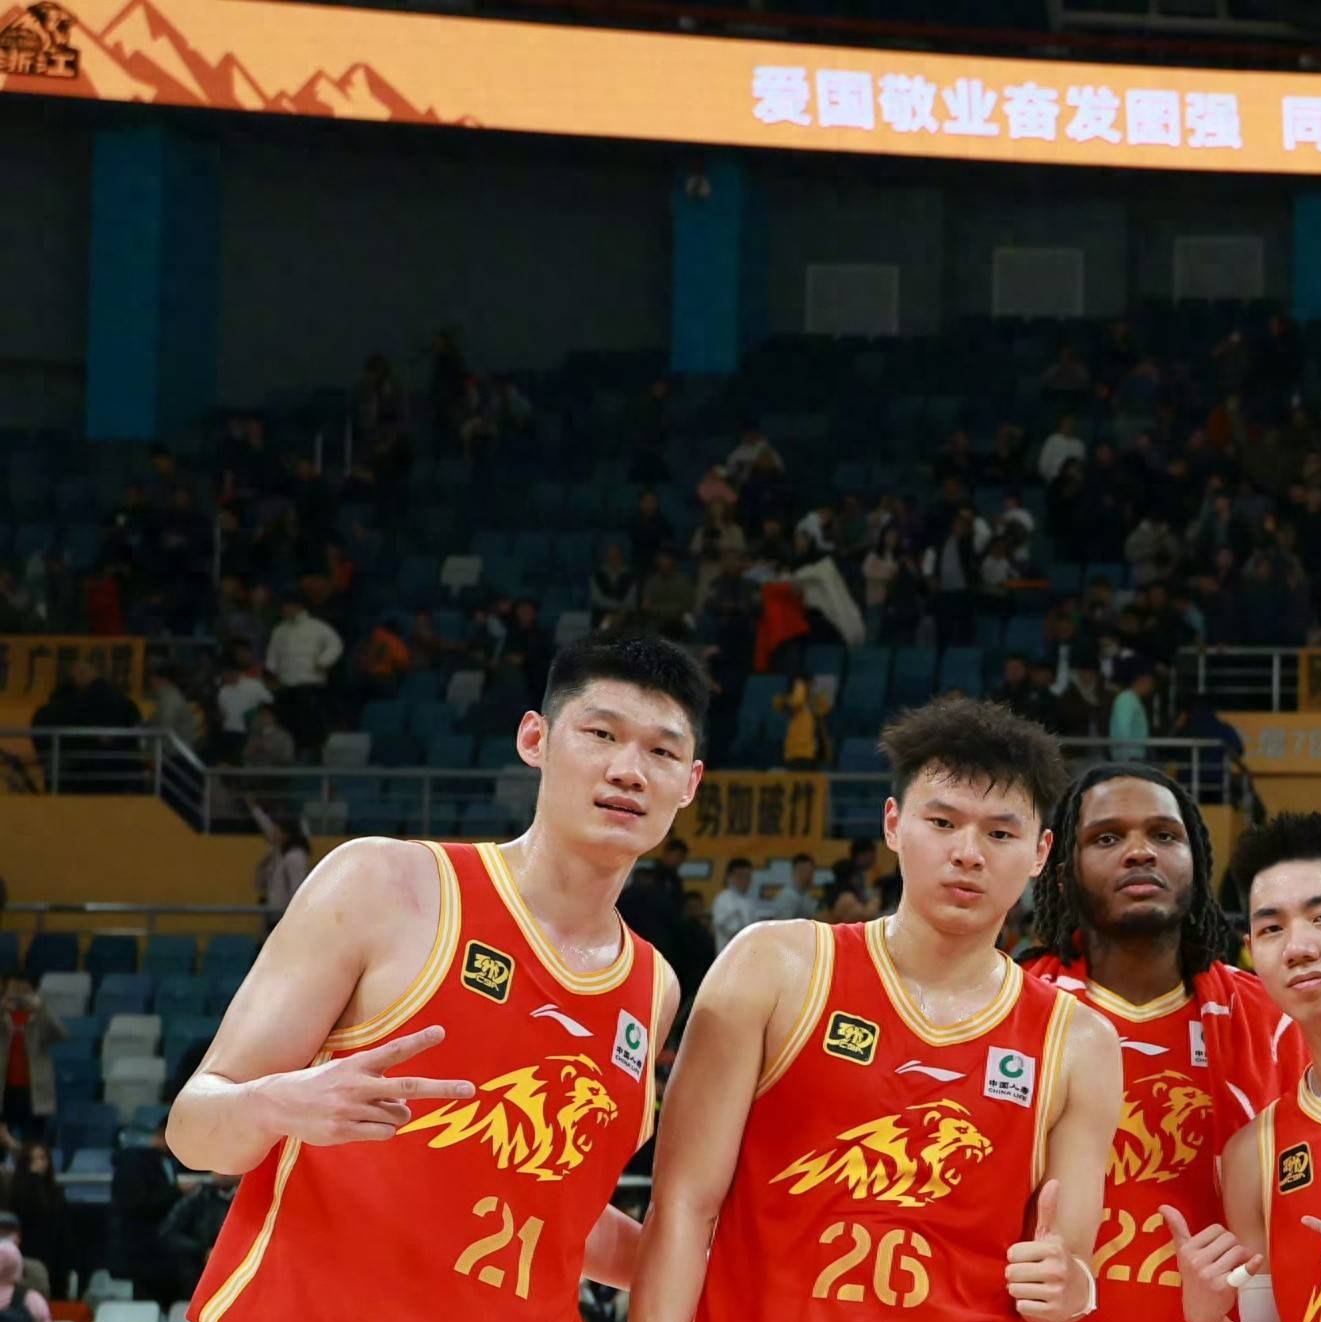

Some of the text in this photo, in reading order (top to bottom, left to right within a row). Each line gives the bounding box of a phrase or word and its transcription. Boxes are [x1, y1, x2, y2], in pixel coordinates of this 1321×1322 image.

[752, 65, 1243, 149] 爱国敬业奋发图强
[988, 1080, 1029, 1096] 中国人寿
[453, 1196, 544, 1299] 21
[812, 1222, 932, 1308] 26
[1093, 1207, 1182, 1288] 22
